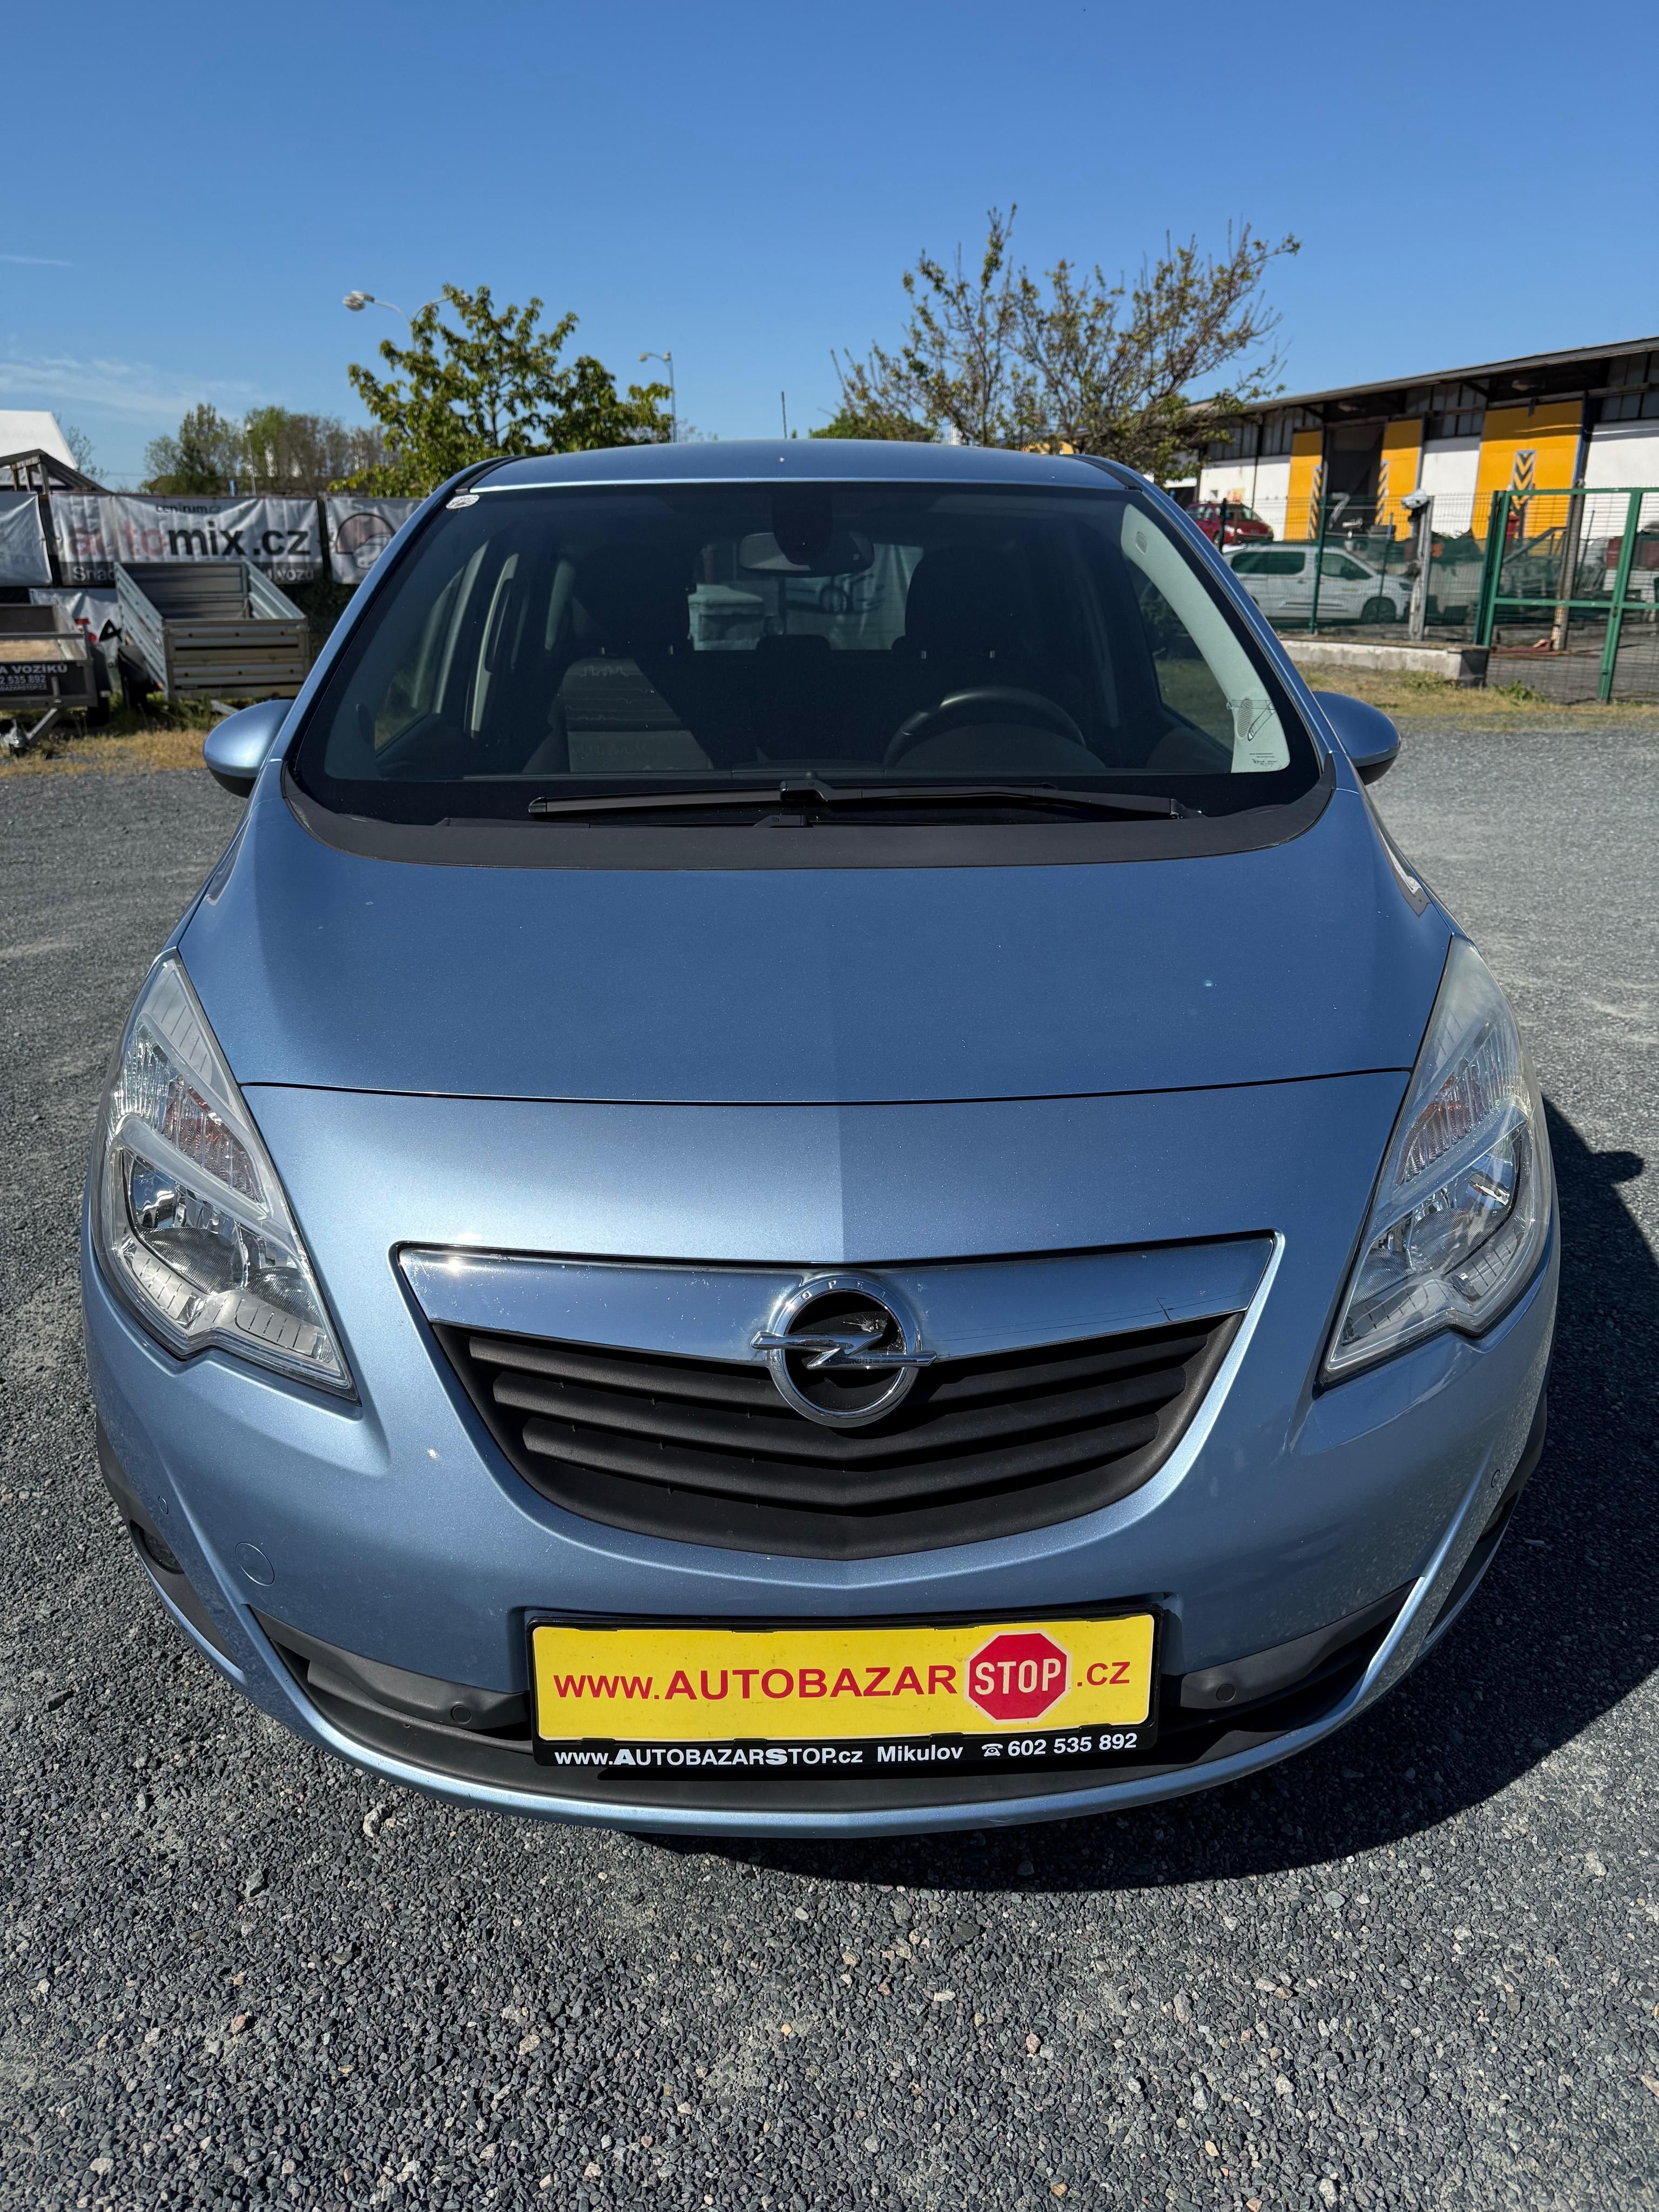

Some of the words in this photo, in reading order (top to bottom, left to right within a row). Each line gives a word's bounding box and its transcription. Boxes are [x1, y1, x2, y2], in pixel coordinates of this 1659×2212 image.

[69, 520, 310, 556] automix.cz
[877, 1744, 963, 1762] Mikulov
[1007, 1739, 1047, 1756] 602
[1054, 1736, 1092, 1754] 535
[1098, 1732, 1138, 1750] 892
